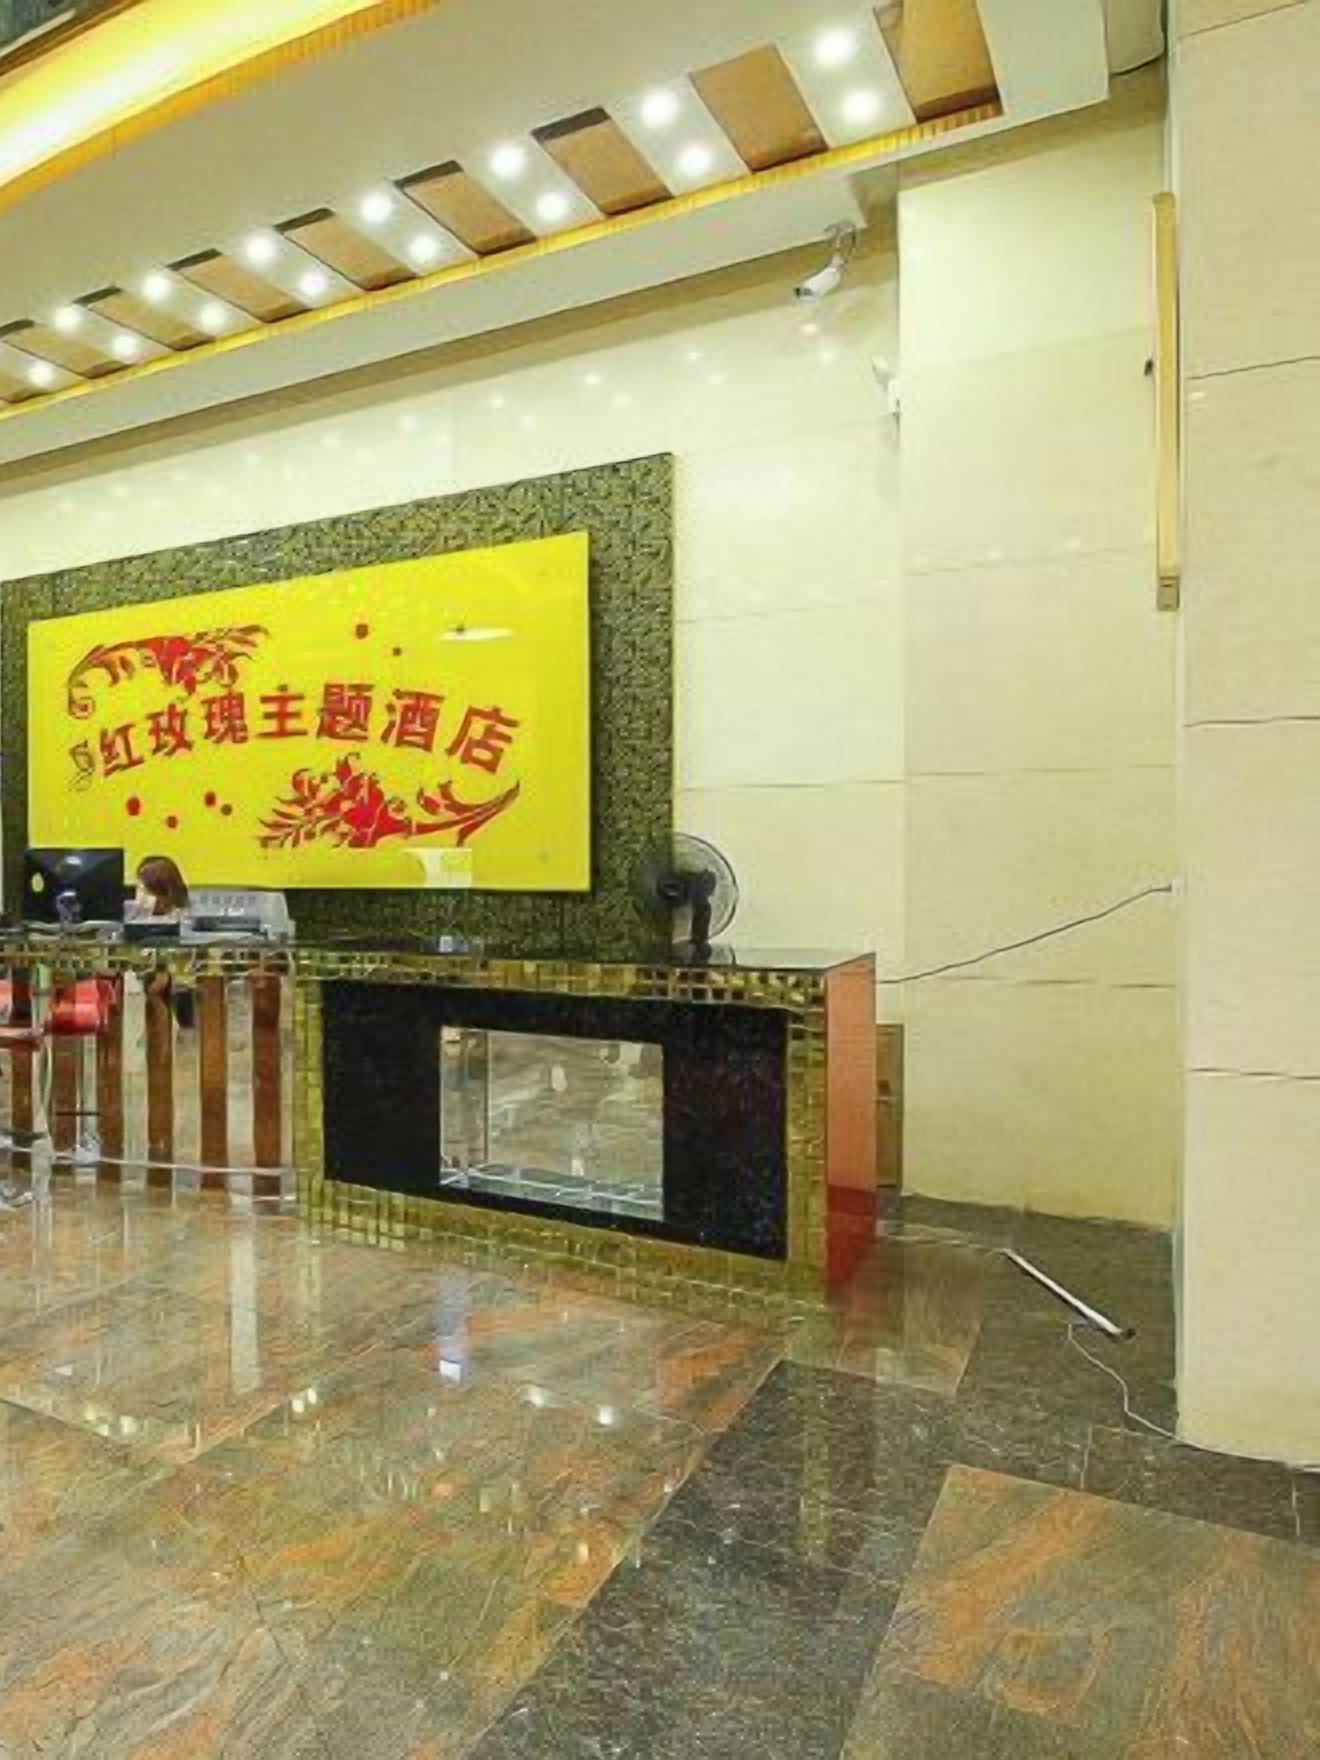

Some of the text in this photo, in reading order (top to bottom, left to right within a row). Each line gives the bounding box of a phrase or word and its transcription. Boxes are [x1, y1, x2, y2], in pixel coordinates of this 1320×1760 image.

[98, 682, 519, 775] 红玫瑰主题酒店
